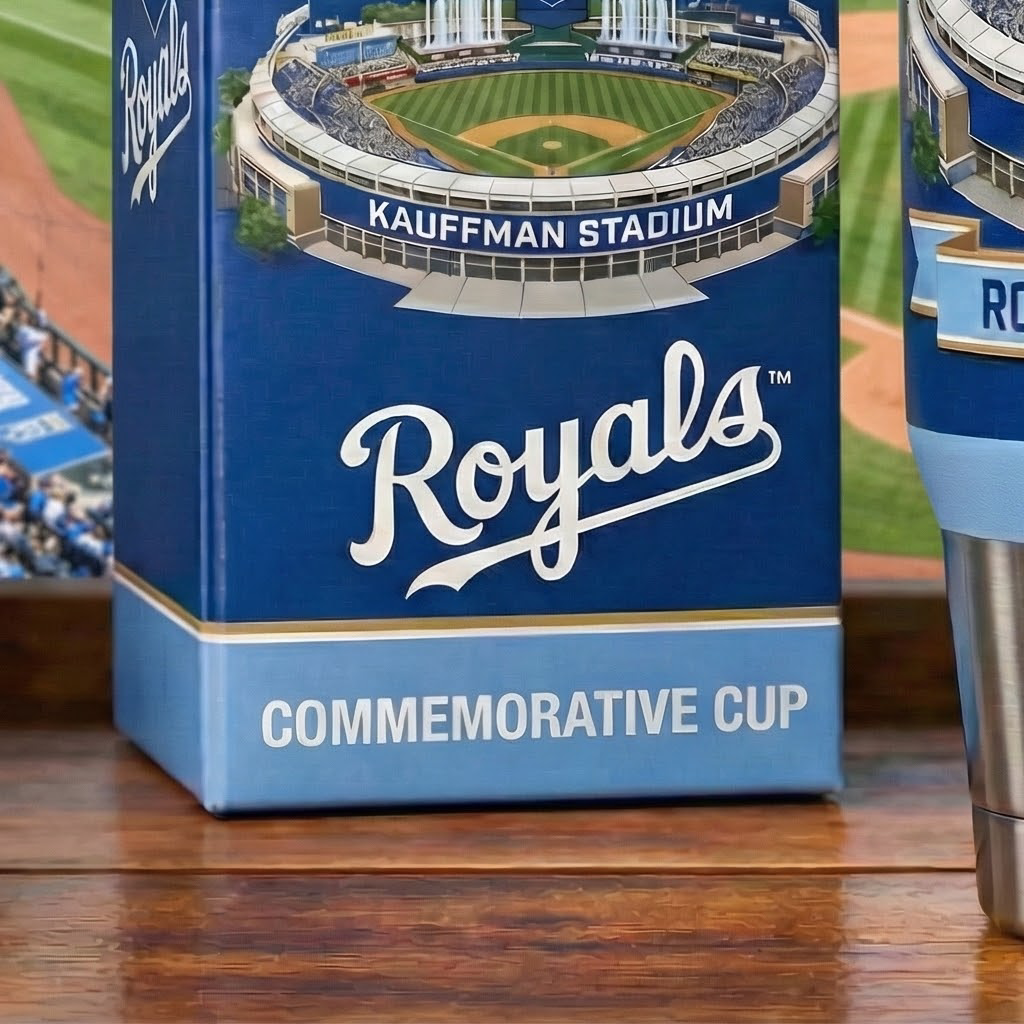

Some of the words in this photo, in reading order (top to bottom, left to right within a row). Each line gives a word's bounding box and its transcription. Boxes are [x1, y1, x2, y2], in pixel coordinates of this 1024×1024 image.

[369, 198, 565, 249] KAUFFMAN
[578, 193, 733, 246] STADIUM
[767, 370, 792, 385] TM
[340, 339, 782, 600] Royals
[261, 686, 699, 749] COMMEMORATIVE
[713, 683, 808, 733] CUP
